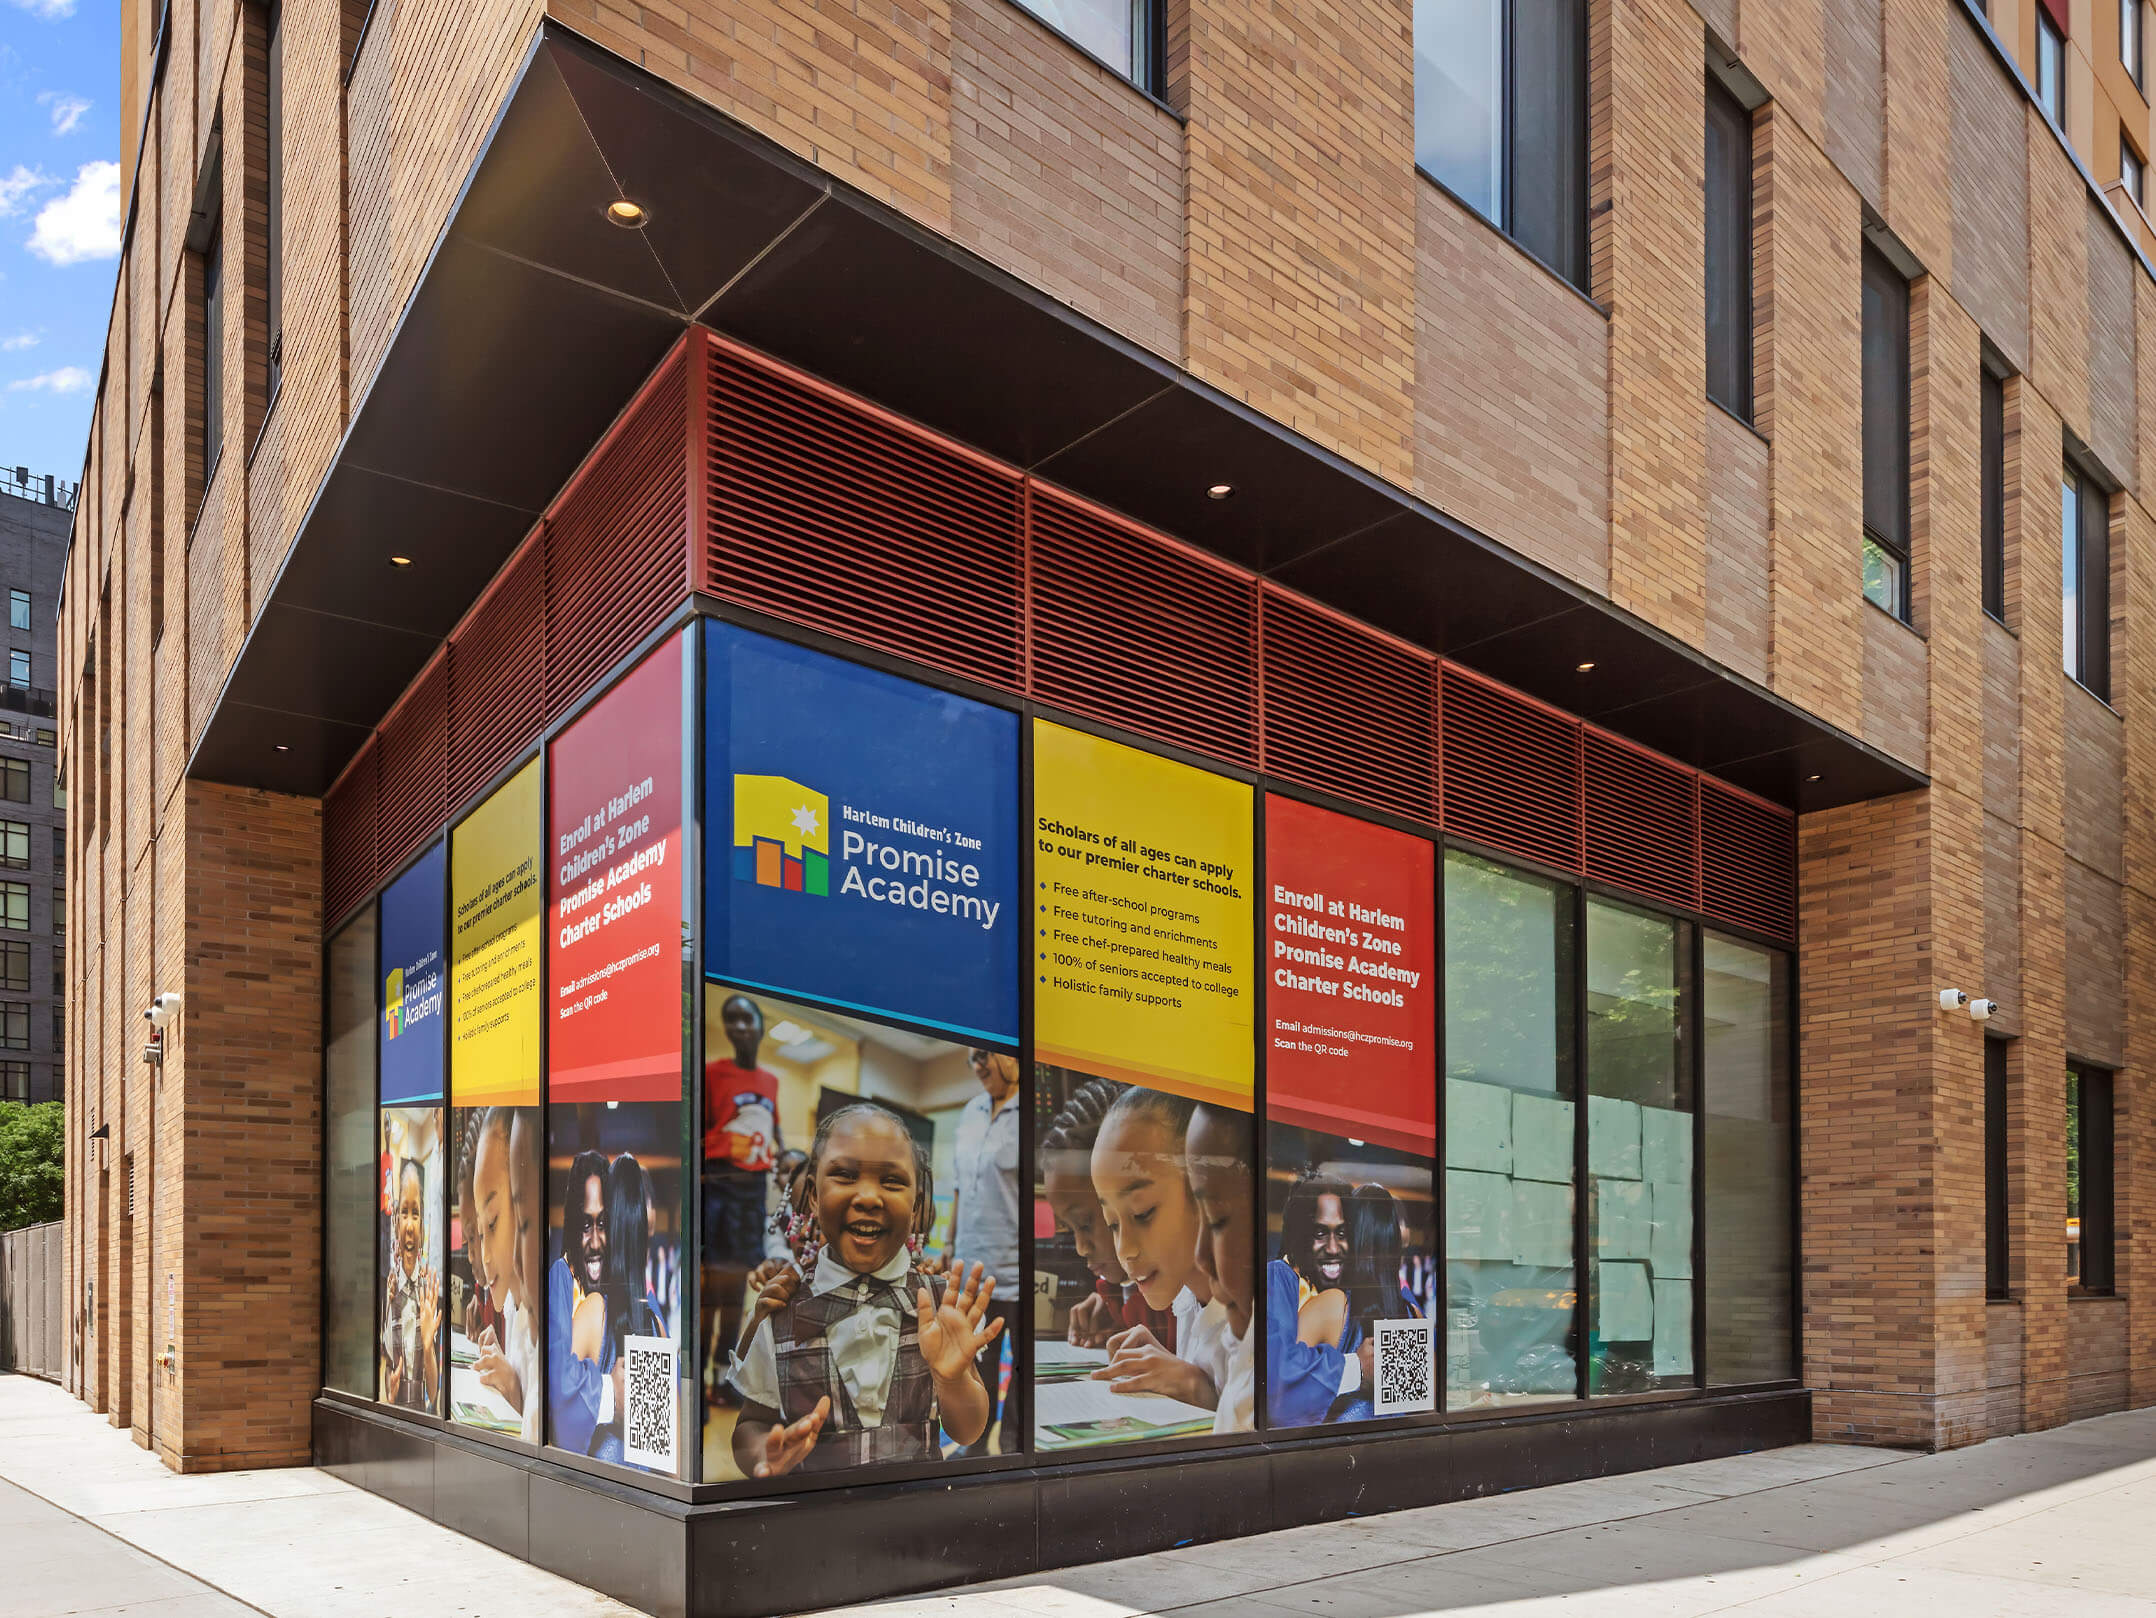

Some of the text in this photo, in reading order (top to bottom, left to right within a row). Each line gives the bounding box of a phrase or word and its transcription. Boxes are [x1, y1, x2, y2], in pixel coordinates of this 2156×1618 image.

[560, 777, 653, 856] Enroll at Harlem
[843, 806, 982, 850] Harlem Children's Zone
[560, 815, 649, 886] Children's Zone
[843, 831, 980, 887] Promise
[1039, 818, 1233, 880] Scholars of all ages can apply
[1039, 839, 1241, 899] to our premier charter schools.
[492, 877, 505, 894] ages
[506, 870, 515, 884] can
[517, 856, 532, 876] apply
[560, 839, 667, 918] Promise Academy
[473, 903, 492, 927] premier
[493, 891, 512, 910] charter
[514, 873, 537, 896] schools.
[560, 882, 652, 949] Charter Schools
[841, 866, 1000, 929] Academy
[1054, 883, 1200, 924] Free after-school programs
[1274, 885, 1405, 931] Enroll at Harlem
[1054, 906, 1218, 949] Free tutoring and enrichments
[1274, 913, 1401, 955] Children's Zone
[1054, 930, 1232, 974] Free chef-prepared healthy meals
[1275, 941, 1420, 988] Promise Academy
[405, 971, 437, 1004] Promise
[560, 981, 575, 998] Email
[1054, 953, 1239, 997] 100% of seniors accepted to college
[1054, 977, 1182, 1008] Holistic family supports
[1275, 969, 1404, 1007] Charter Schools
[405, 992, 442, 1028] Academy
[560, 989, 608, 1019] Scan the QR code
[1275, 1039, 1348, 1057] Scan the QR code
[1276, 1019, 1413, 1050] Email admissions@hczpromise.org
